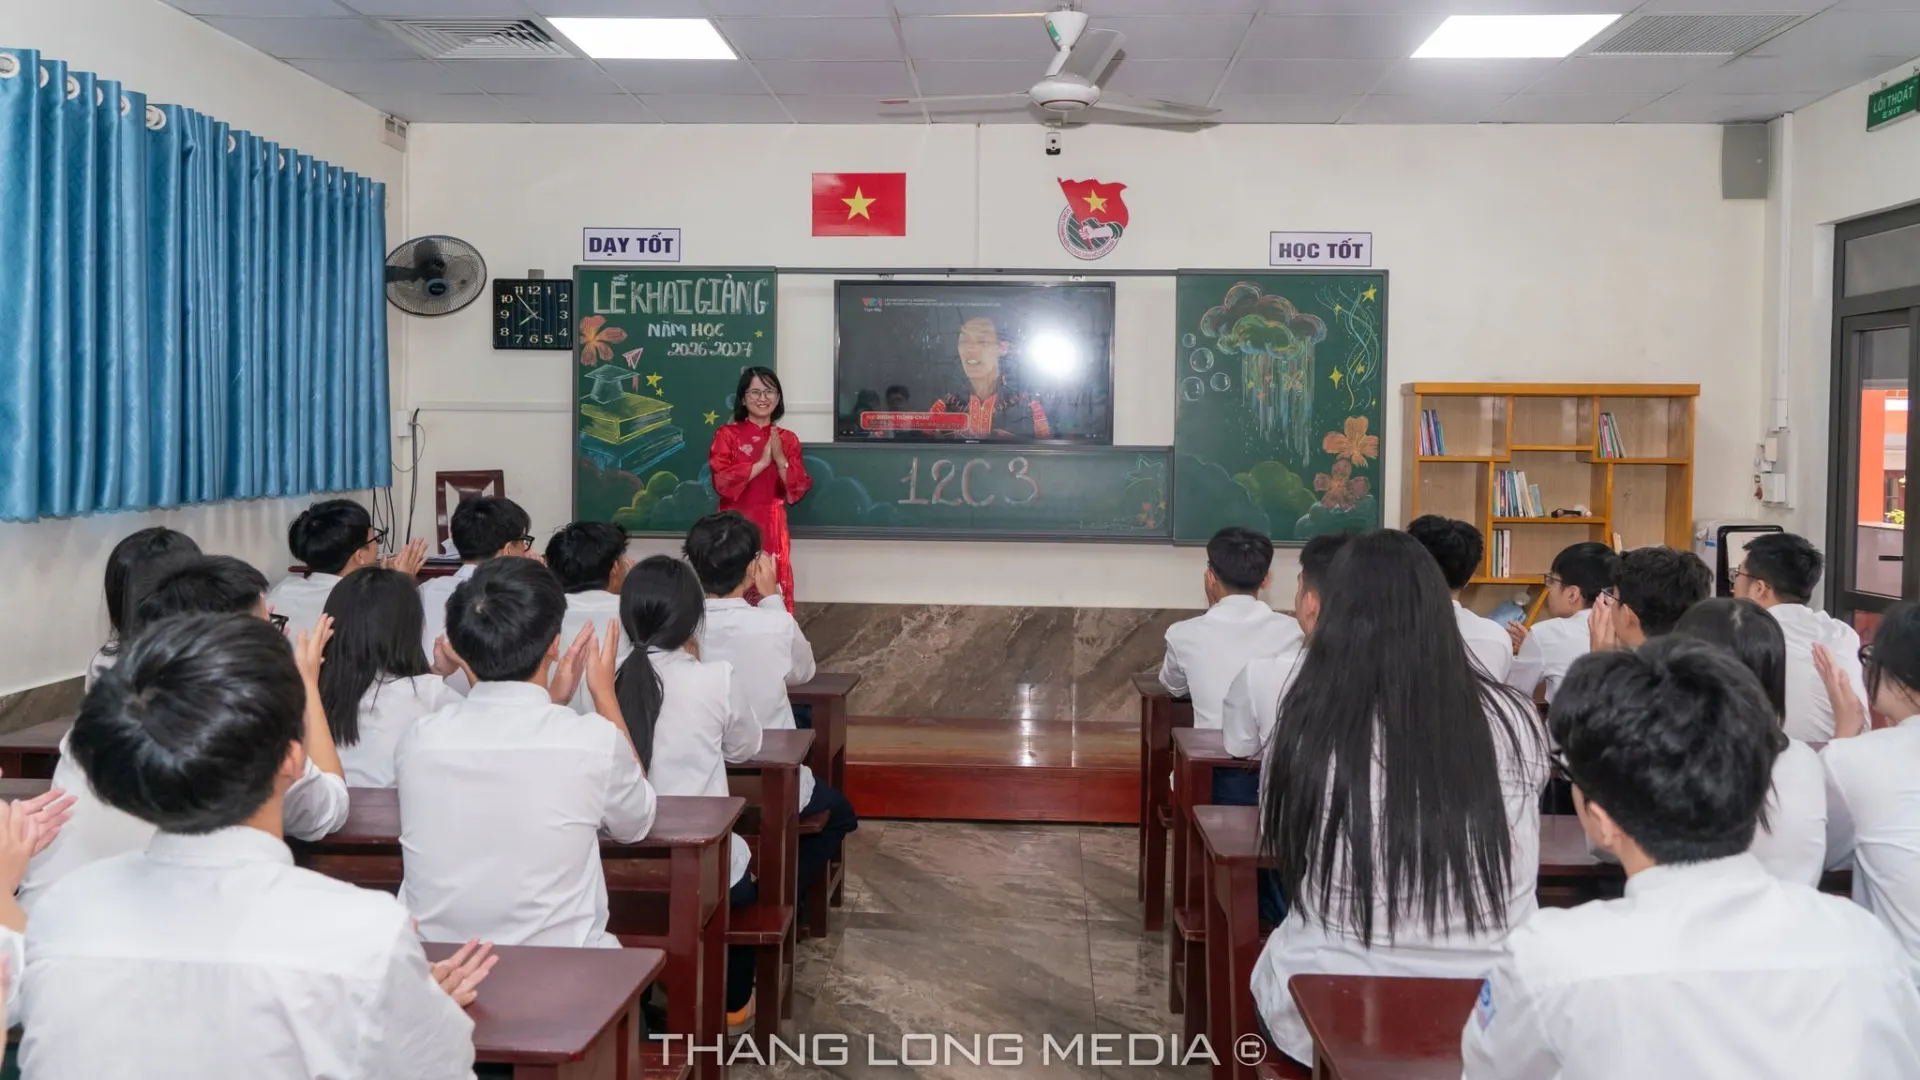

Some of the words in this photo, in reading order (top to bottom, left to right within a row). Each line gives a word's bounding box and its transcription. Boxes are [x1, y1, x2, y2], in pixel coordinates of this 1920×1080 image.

[1882, 105, 1902, 119] EXIT
[589, 237, 630, 256] DẠY
[636, 232, 674, 253] TỐT
[1279, 242, 1320, 262] HỌC
[1326, 238, 1364, 259] TỐT
[527, 285, 541, 295] 12
[546, 286, 552, 295] 1
[501, 294, 514, 304] 10
[559, 293, 569, 303] 2
[631, 279, 694, 315] KHAI
[500, 309, 510, 320] 9
[559, 310, 569, 320] 3
[500, 327, 510, 337] 8
[558, 327, 569, 337] 4
[691, 321, 725, 340] HỌC
[515, 334, 524, 344] 7
[529, 334, 539, 344] 6
[544, 334, 554, 344] 5
